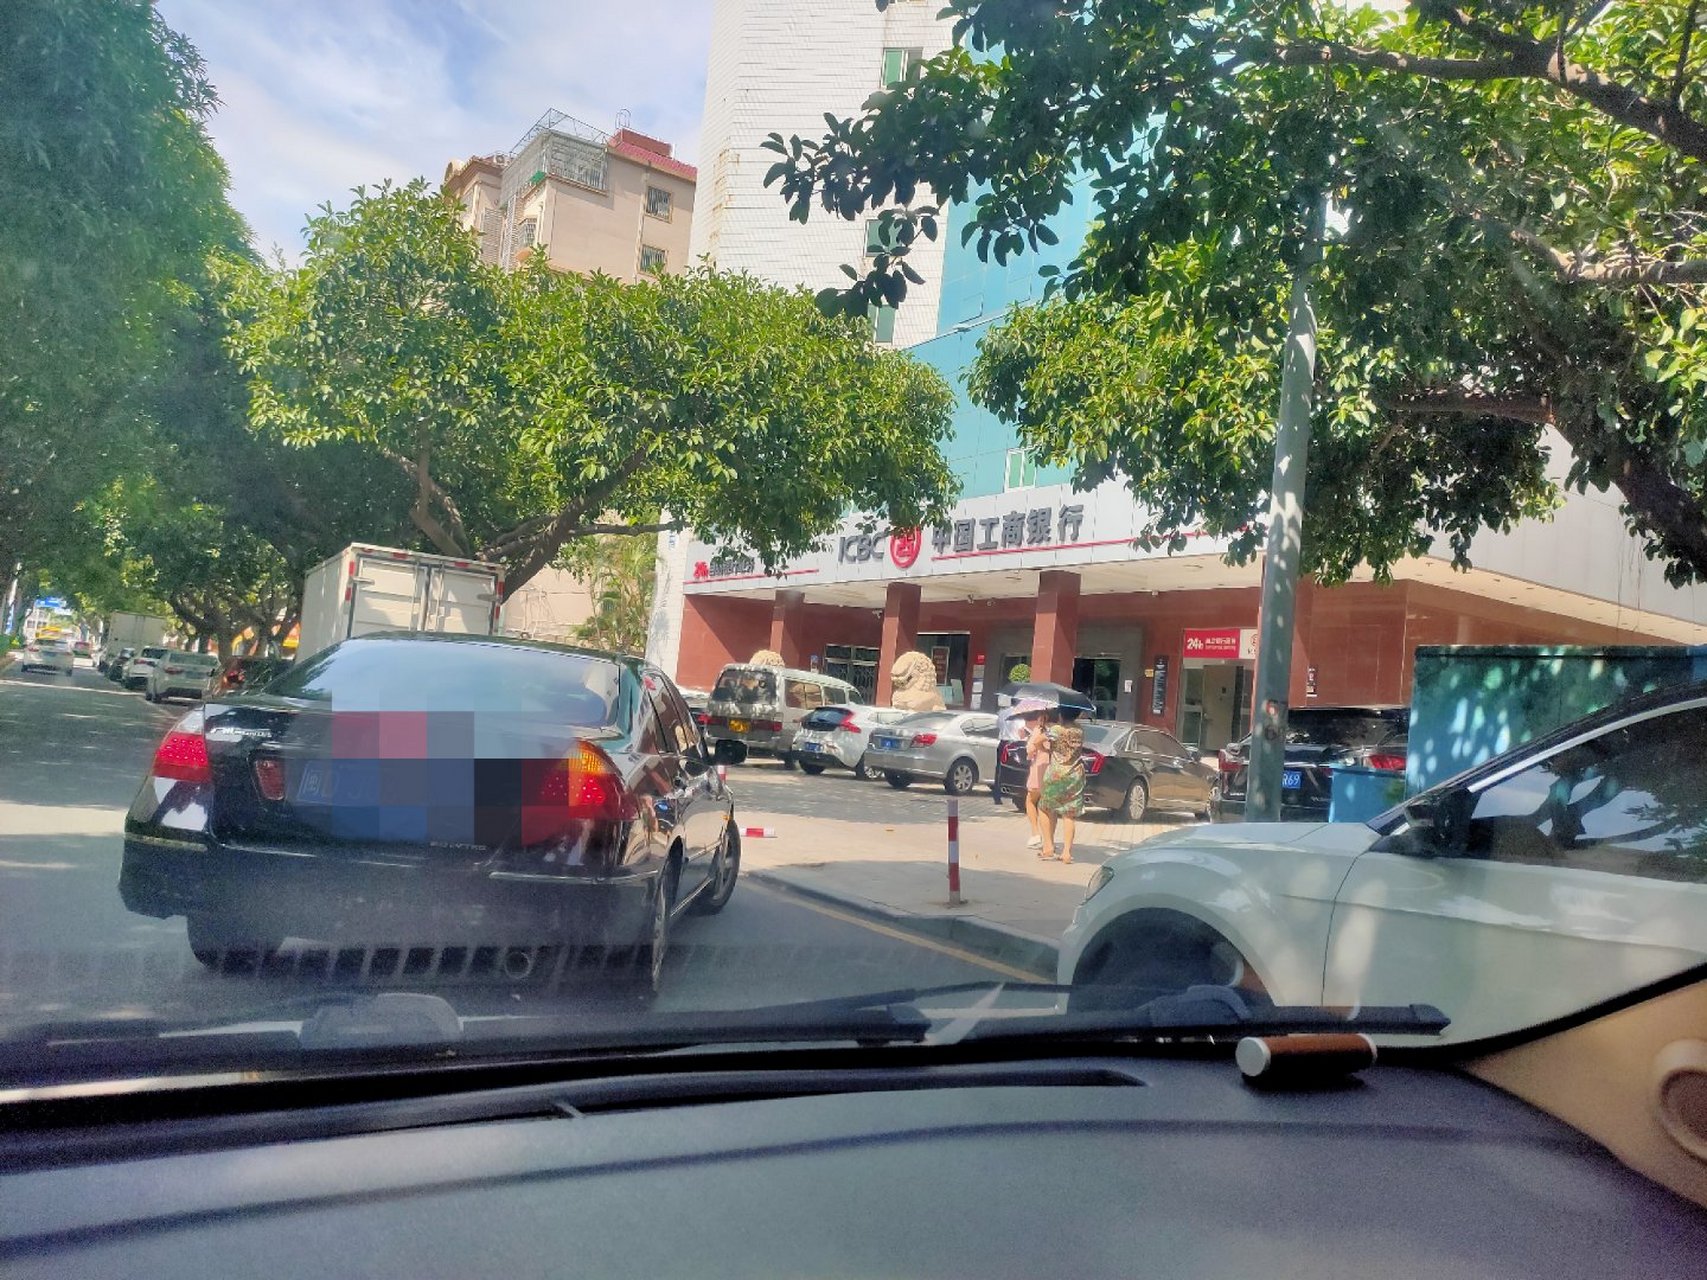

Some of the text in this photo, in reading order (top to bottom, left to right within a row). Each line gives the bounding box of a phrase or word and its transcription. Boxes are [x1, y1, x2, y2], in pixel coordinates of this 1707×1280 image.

[838, 531, 888, 564] ICBC
[931, 504, 1084, 554] 中国工商银行
